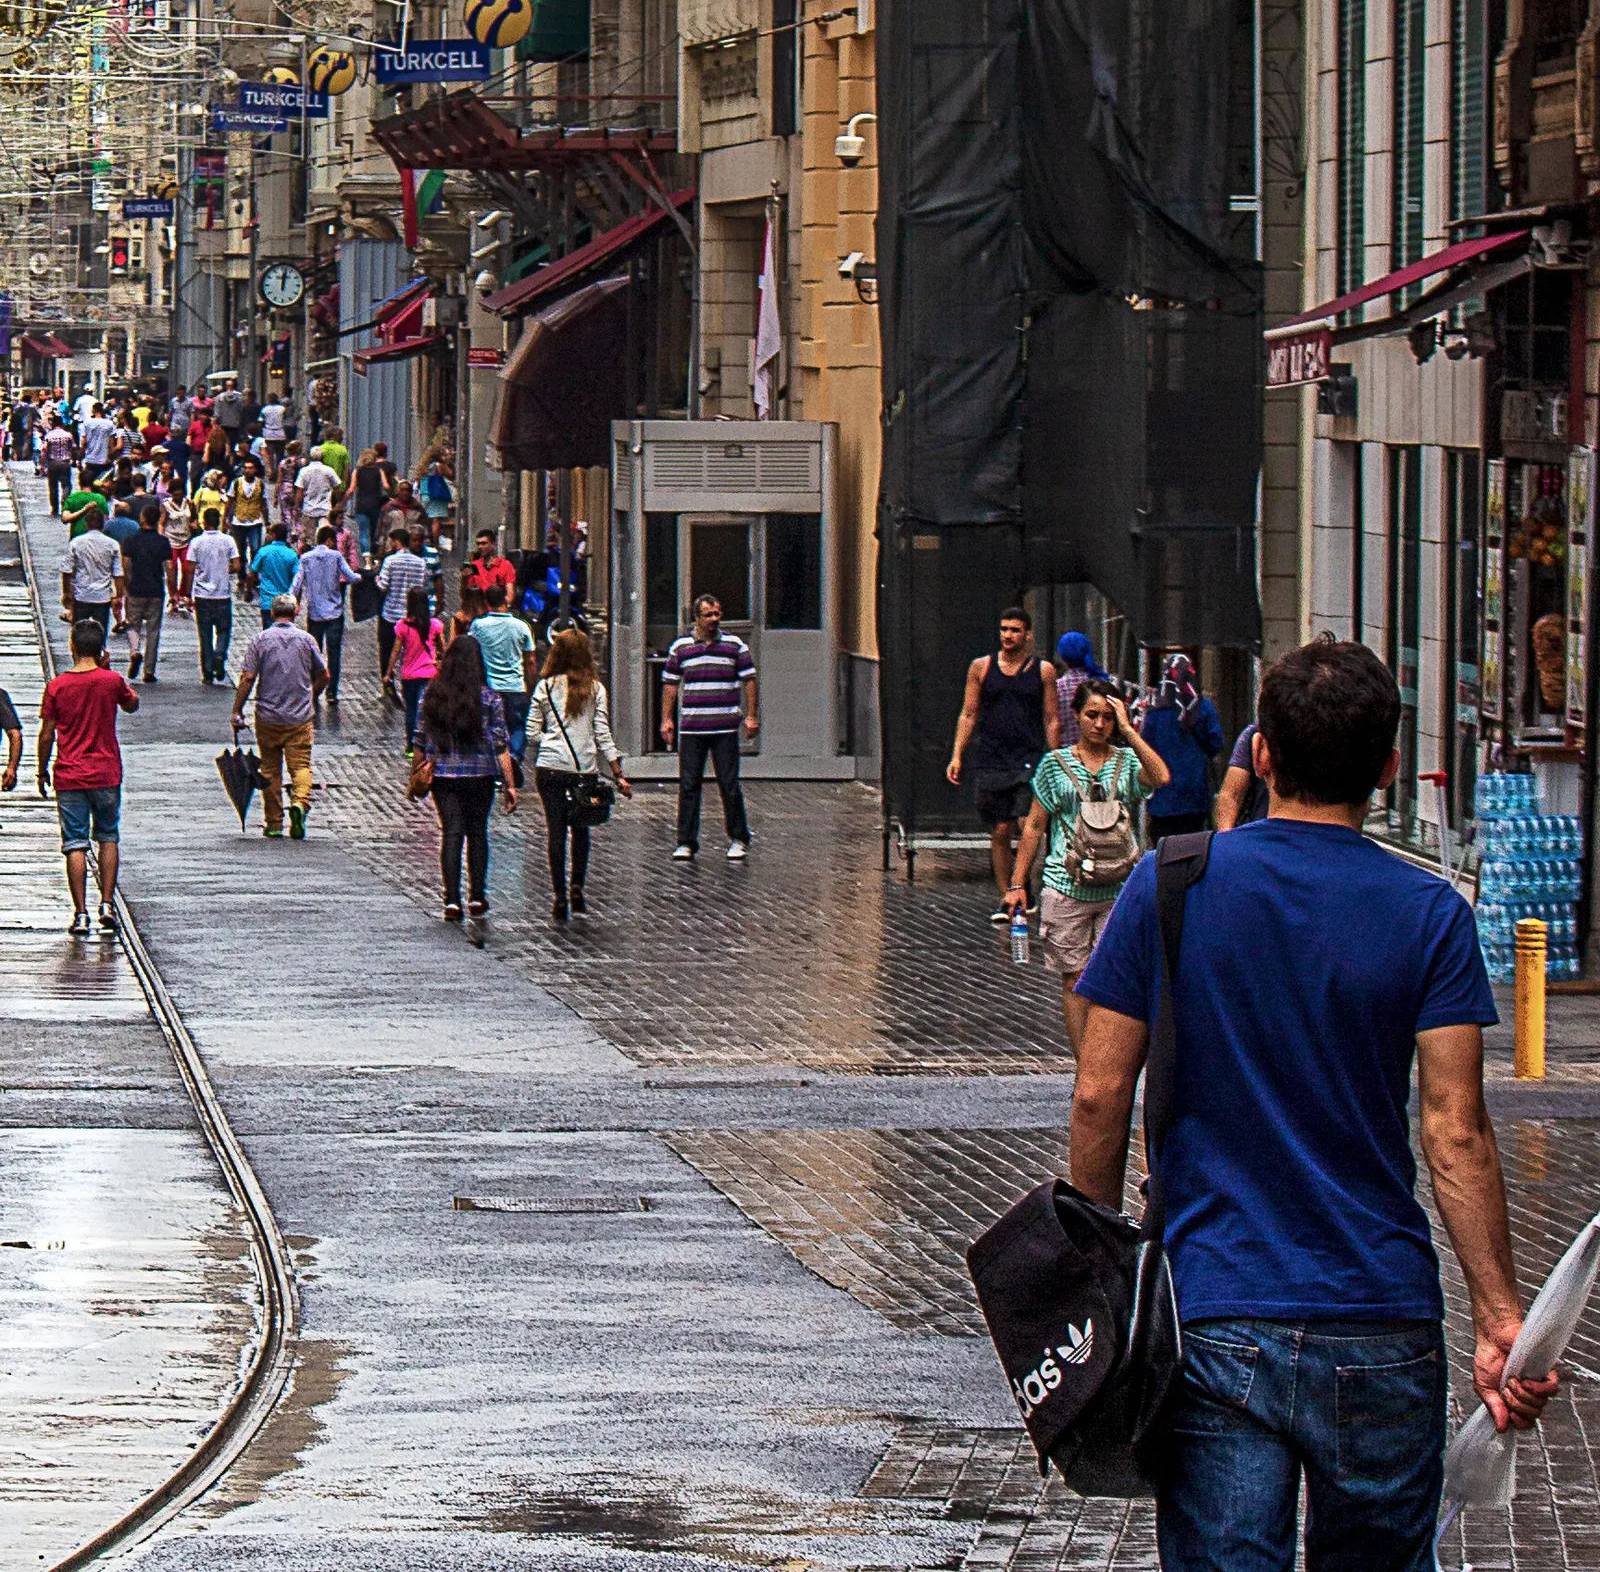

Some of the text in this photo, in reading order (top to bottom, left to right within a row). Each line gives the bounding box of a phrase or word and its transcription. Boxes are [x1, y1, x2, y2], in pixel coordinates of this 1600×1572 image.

[380, 50, 484, 71] TURKCELL
[245, 91, 323, 108] TURKCELL
[125, 203, 171, 213] TURKCELL
